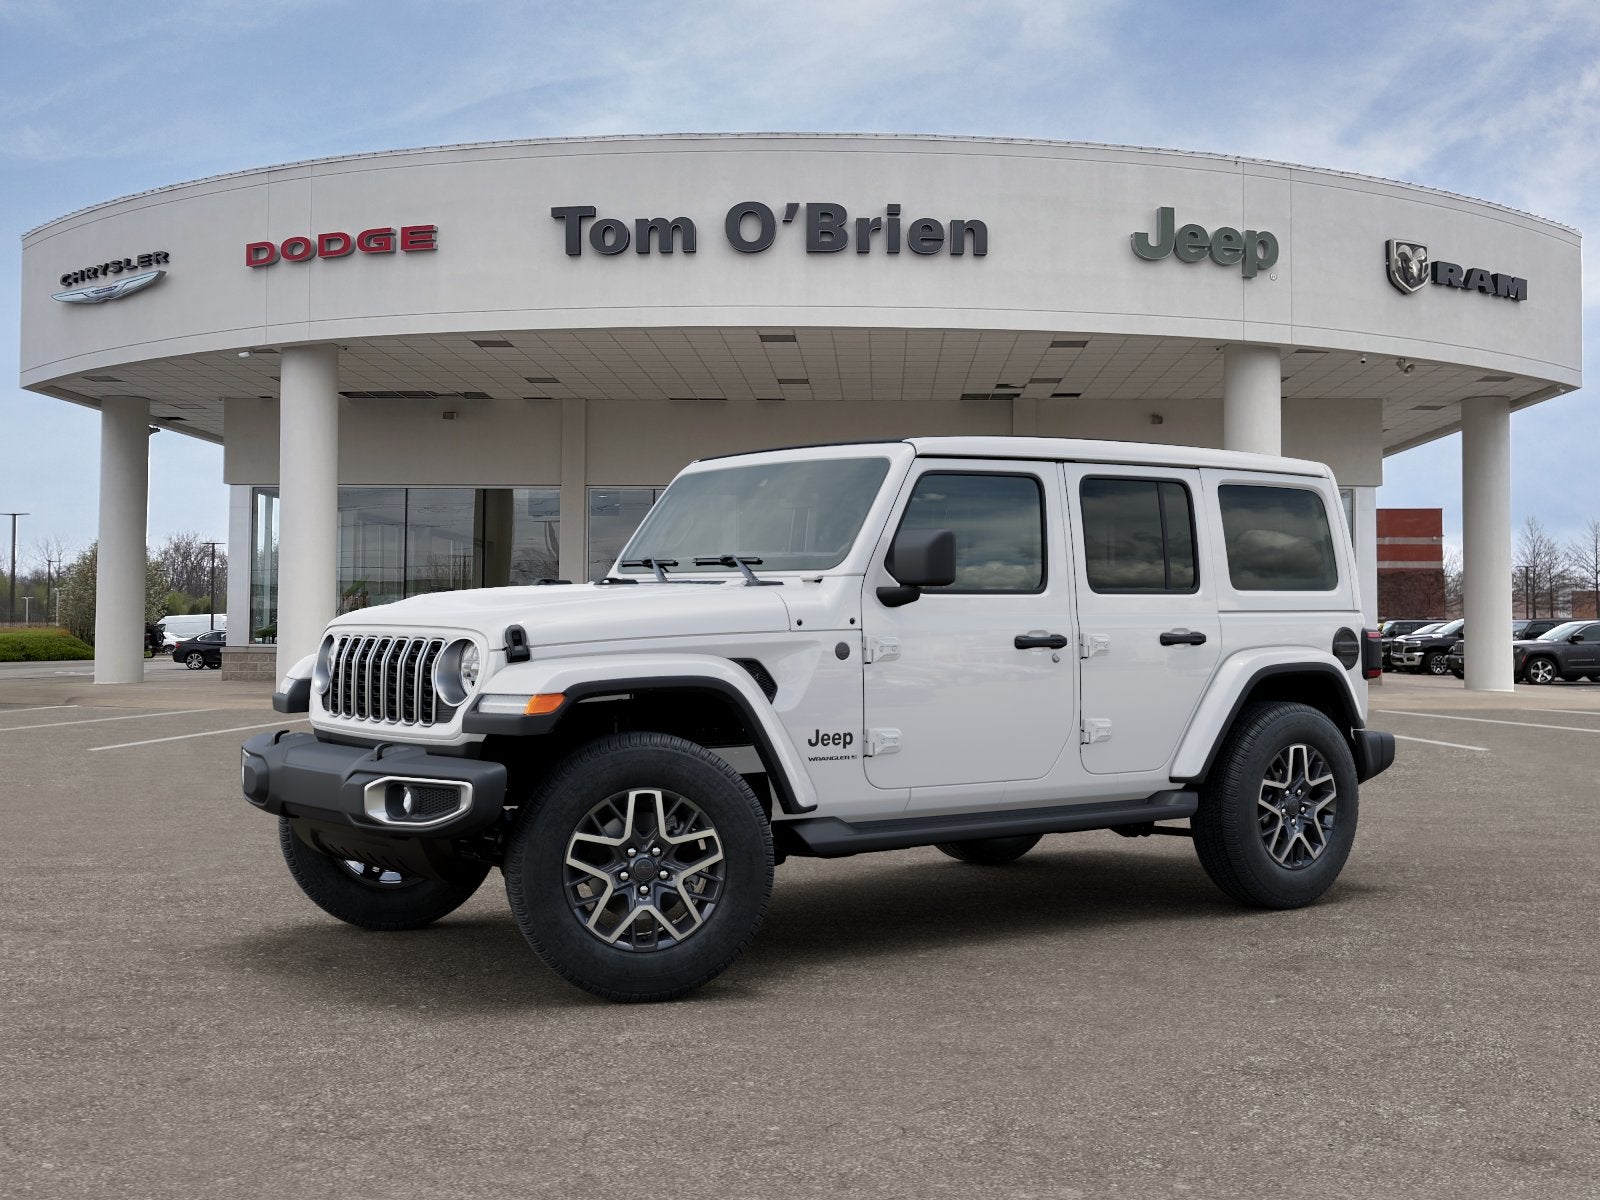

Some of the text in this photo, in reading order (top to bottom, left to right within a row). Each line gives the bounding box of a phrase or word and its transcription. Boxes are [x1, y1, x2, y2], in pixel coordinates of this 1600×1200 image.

[246, 224, 438, 268] DODGE
[551, 201, 988, 256] Tom O'Brien
[1131, 206, 1279, 279] Jeep
[60, 251, 170, 287] CHRYSLER
[1431, 261, 1528, 301] RAM
[808, 729, 854, 749] Jeep
